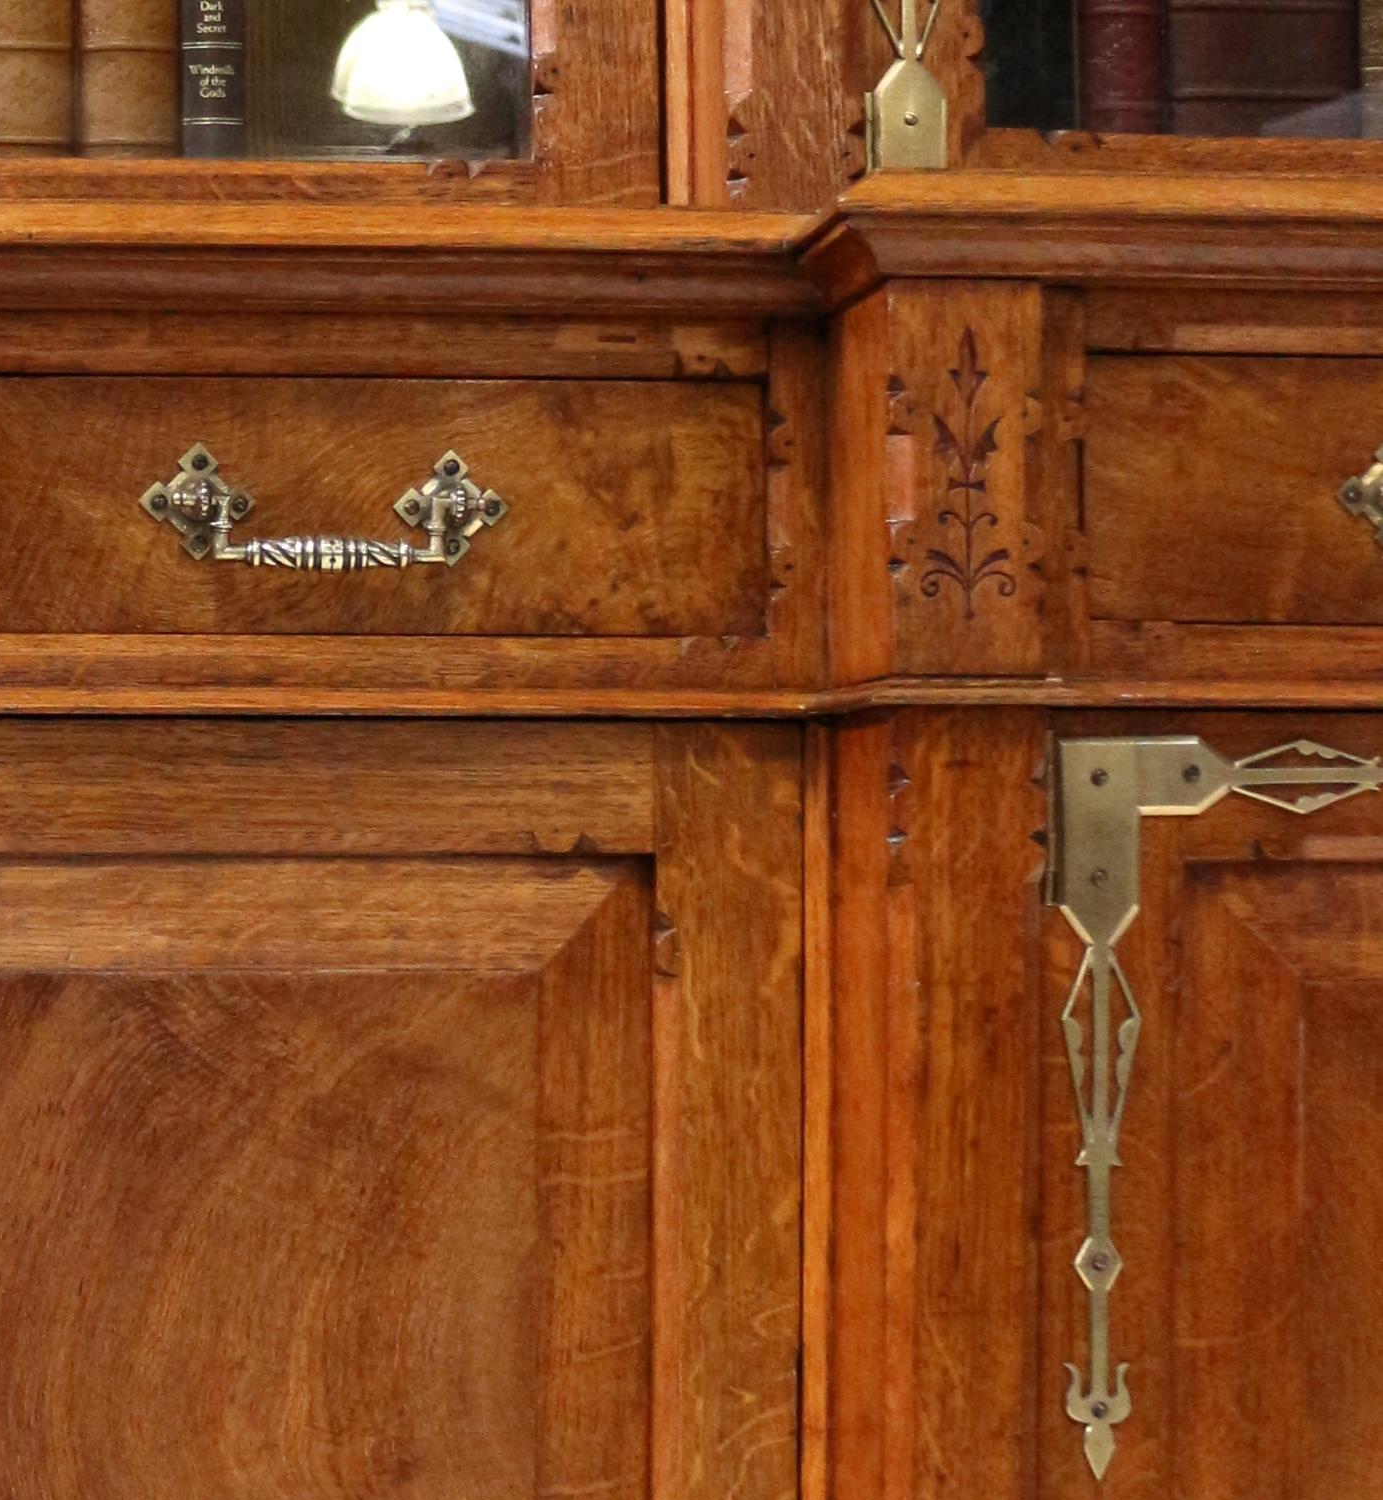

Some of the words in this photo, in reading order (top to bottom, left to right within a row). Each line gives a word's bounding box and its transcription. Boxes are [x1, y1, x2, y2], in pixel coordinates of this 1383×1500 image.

[200, 0, 224, 11] Dark
[203, 12, 222, 22] and
[196, 22, 226, 33] Secret
[199, 75, 210, 87] of
[211, 76, 226, 87] the
[199, 87, 226, 98] Gods
